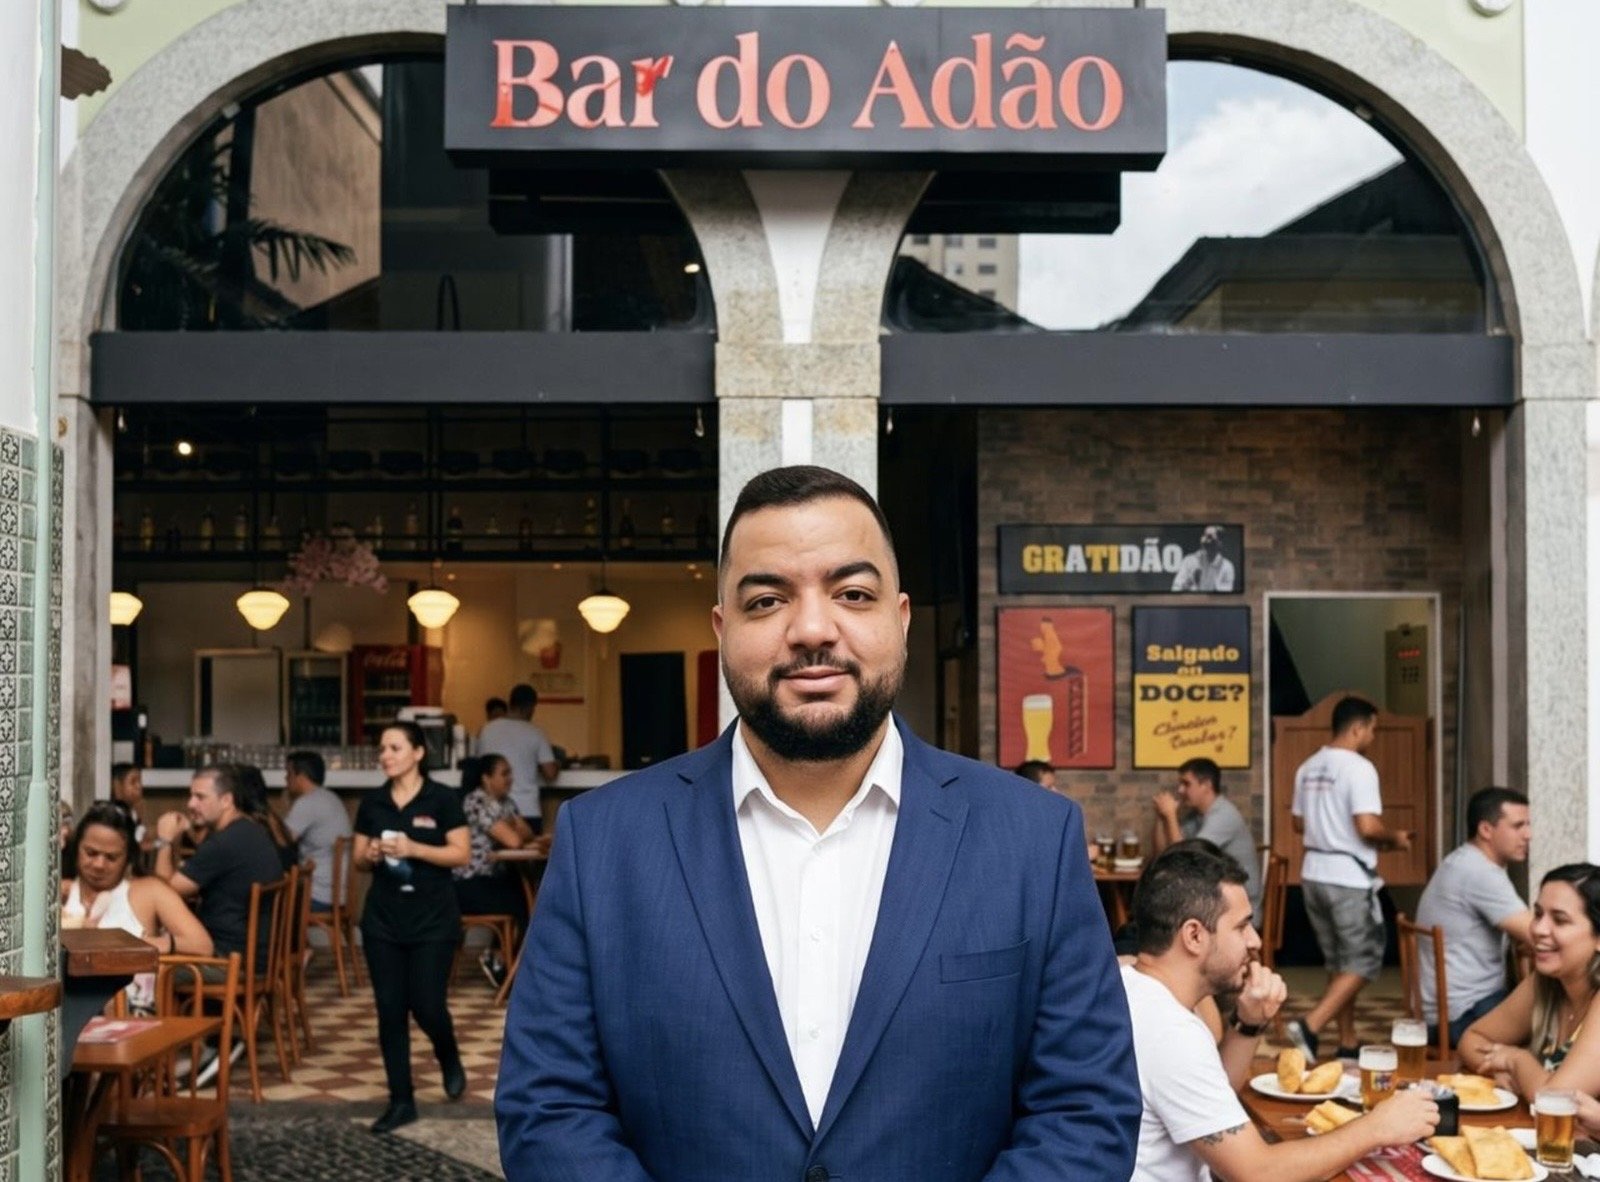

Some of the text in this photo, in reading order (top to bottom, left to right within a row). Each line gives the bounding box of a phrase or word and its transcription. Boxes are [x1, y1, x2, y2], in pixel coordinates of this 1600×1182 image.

[490, 31, 1124, 131] Bar do Adão
[1022, 537, 1184, 574] GRATIDÃO
[1146, 644, 1240, 665] Salgado
[1140, 684, 1245, 702] DOCE?
